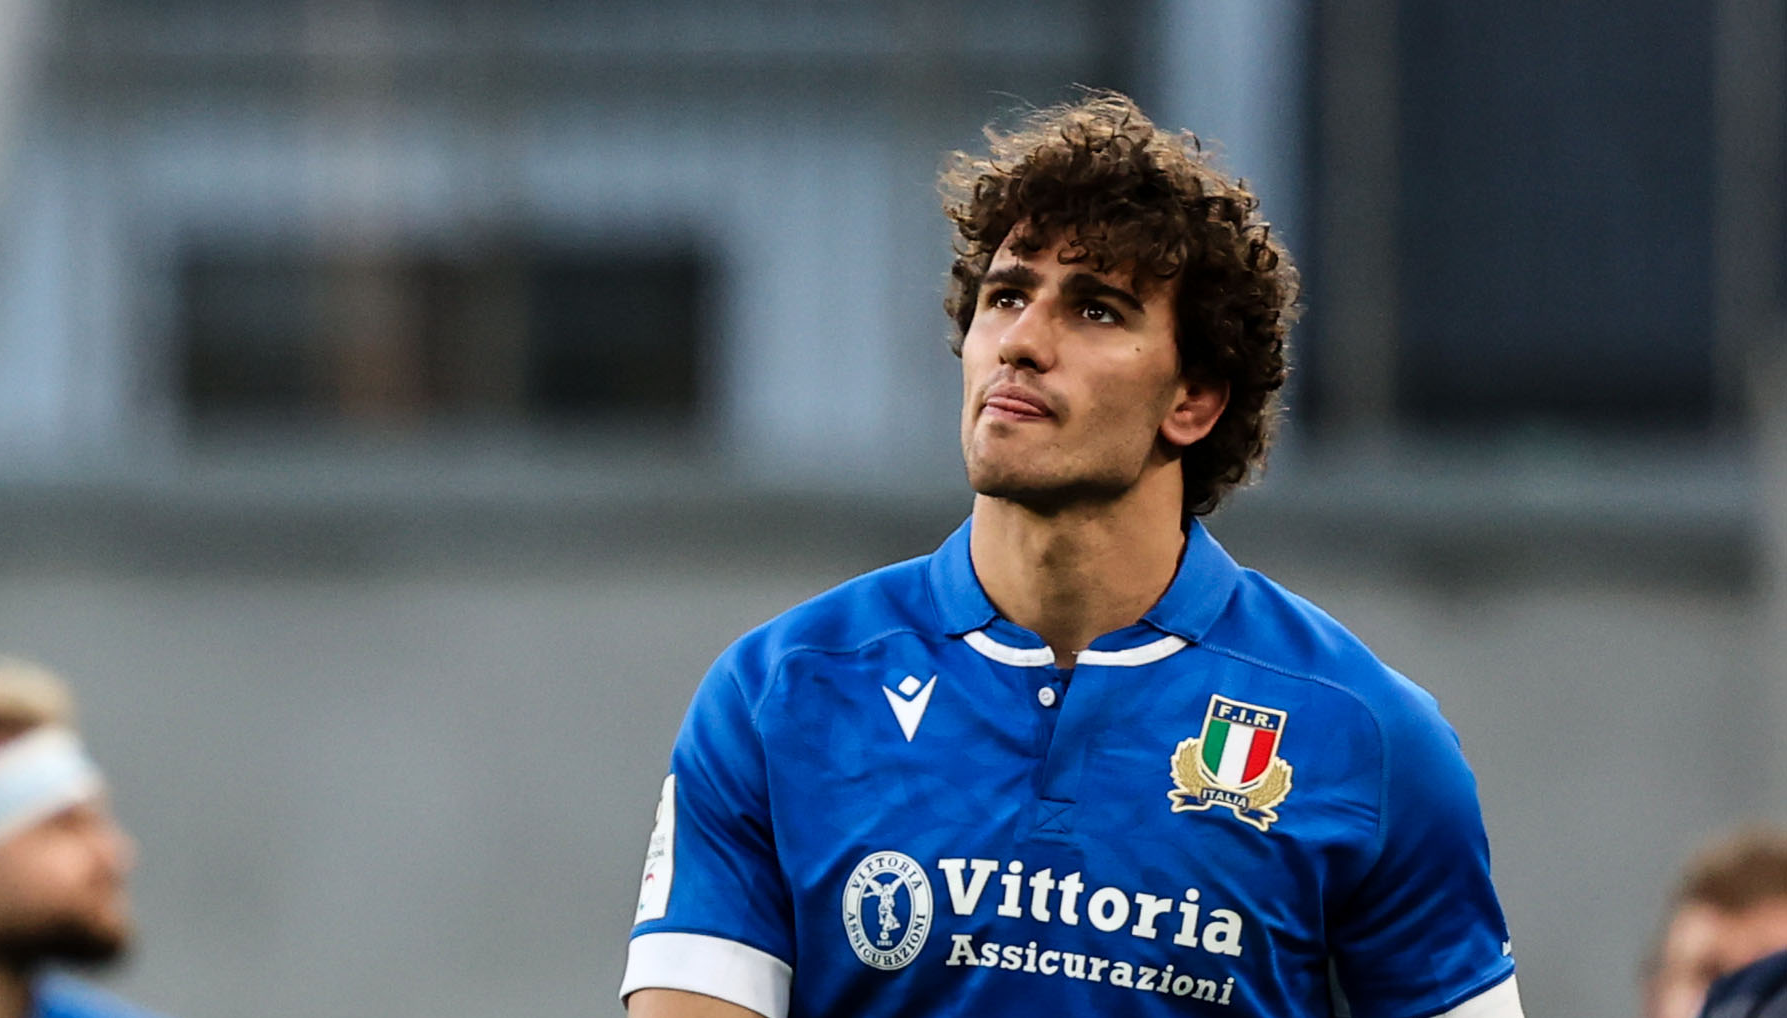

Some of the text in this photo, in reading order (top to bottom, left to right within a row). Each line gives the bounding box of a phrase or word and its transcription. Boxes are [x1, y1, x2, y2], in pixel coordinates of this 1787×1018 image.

[1217, 703, 1274, 729] F.I.R.
[1201, 789, 1247, 807] ITALIA
[851, 857, 923, 891] VITTORIA
[937, 858, 1244, 957] Vittoria
[847, 911, 926, 966] ASSICURAZIONI
[945, 934, 1236, 1006] Assicurazioni
